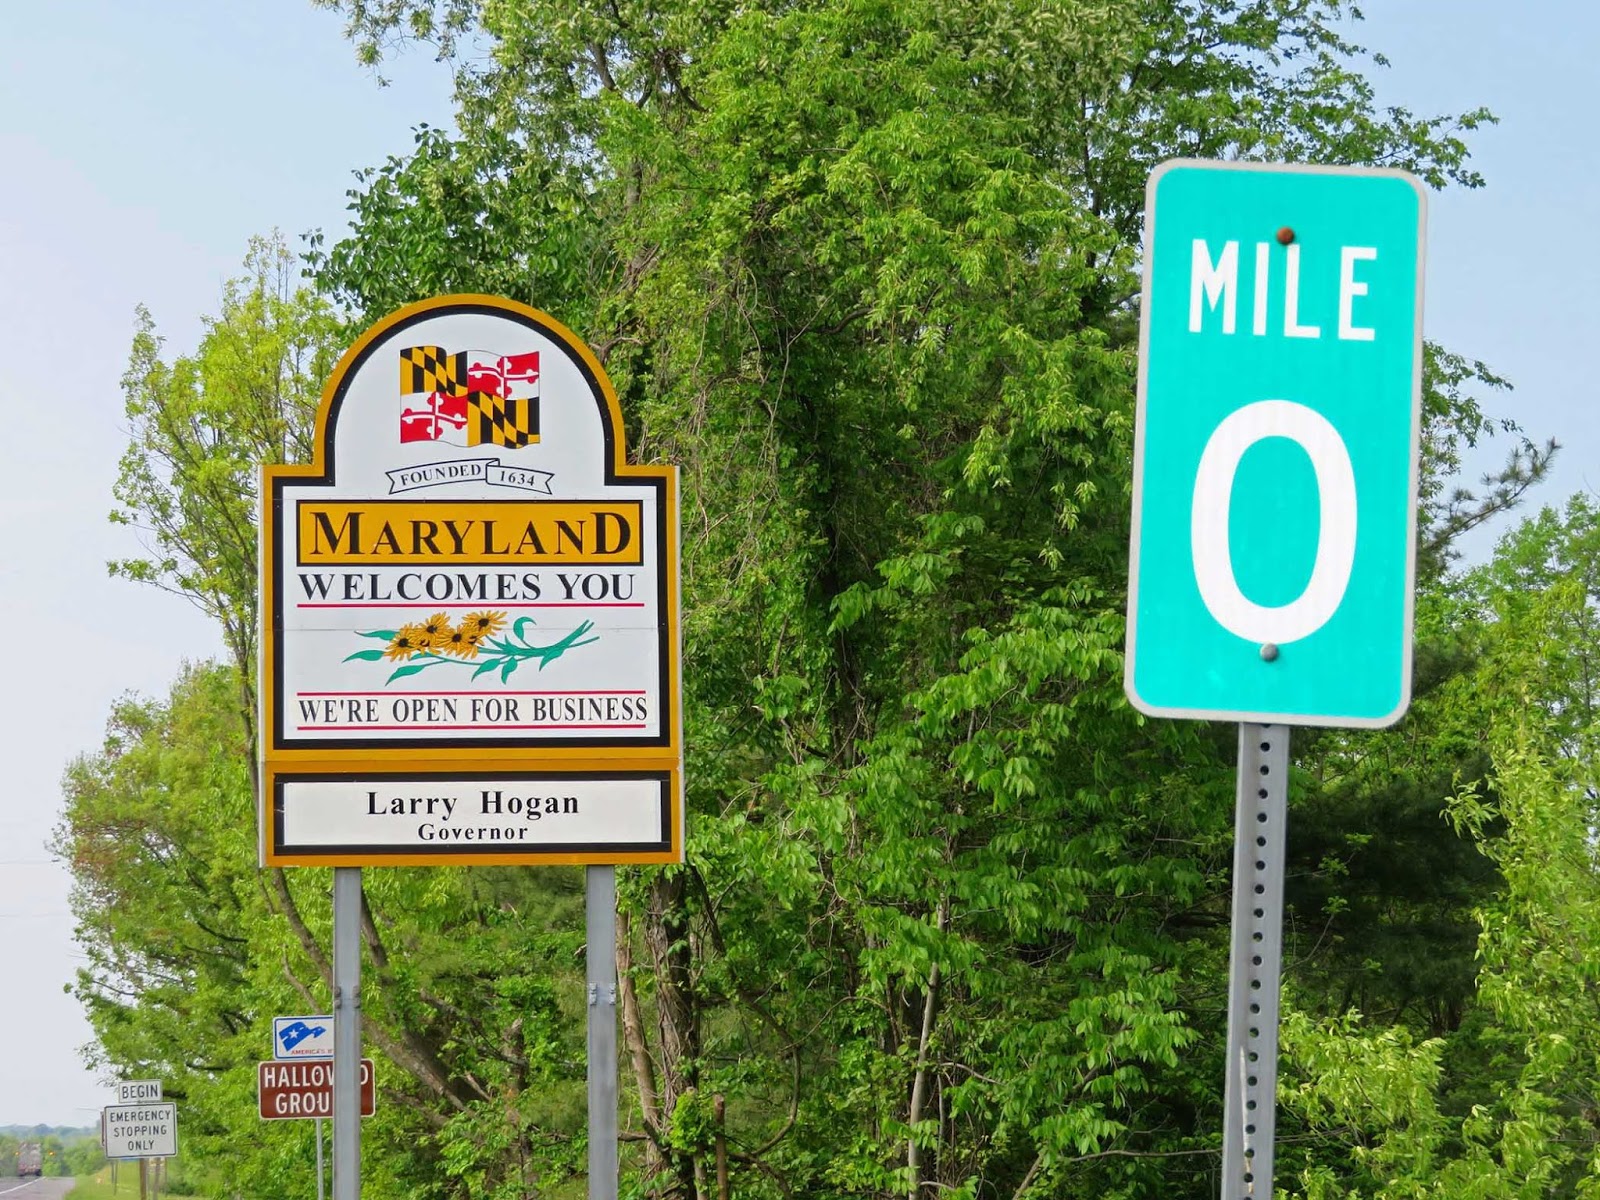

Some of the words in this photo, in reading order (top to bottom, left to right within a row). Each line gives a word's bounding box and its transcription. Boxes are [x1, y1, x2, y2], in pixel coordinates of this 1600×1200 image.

[1188, 238, 1378, 341] MILE
[401, 464, 481, 486] FOUNDED
[500, 471, 535, 486] 1634
[1190, 400, 1358, 645] 0
[299, 573, 541, 602] WELCOMES
[557, 573, 637, 601] YOU
[300, 699, 380, 723] WE'RE
[392, 699, 458, 722] OPEN
[471, 698, 519, 722] FOR
[533, 696, 648, 722] BUSINESS
[366, 791, 458, 821] Larry
[480, 791, 580, 819] Hogan
[418, 823, 529, 841] Governor
[264, 1064, 369, 1088] HALLOD
[122, 1085, 158, 1099] BEGIN
[110, 1110, 171, 1122] EMERGENCY
[114, 1125, 167, 1137] STOPPING
[127, 1140, 154, 1151] ONLY
